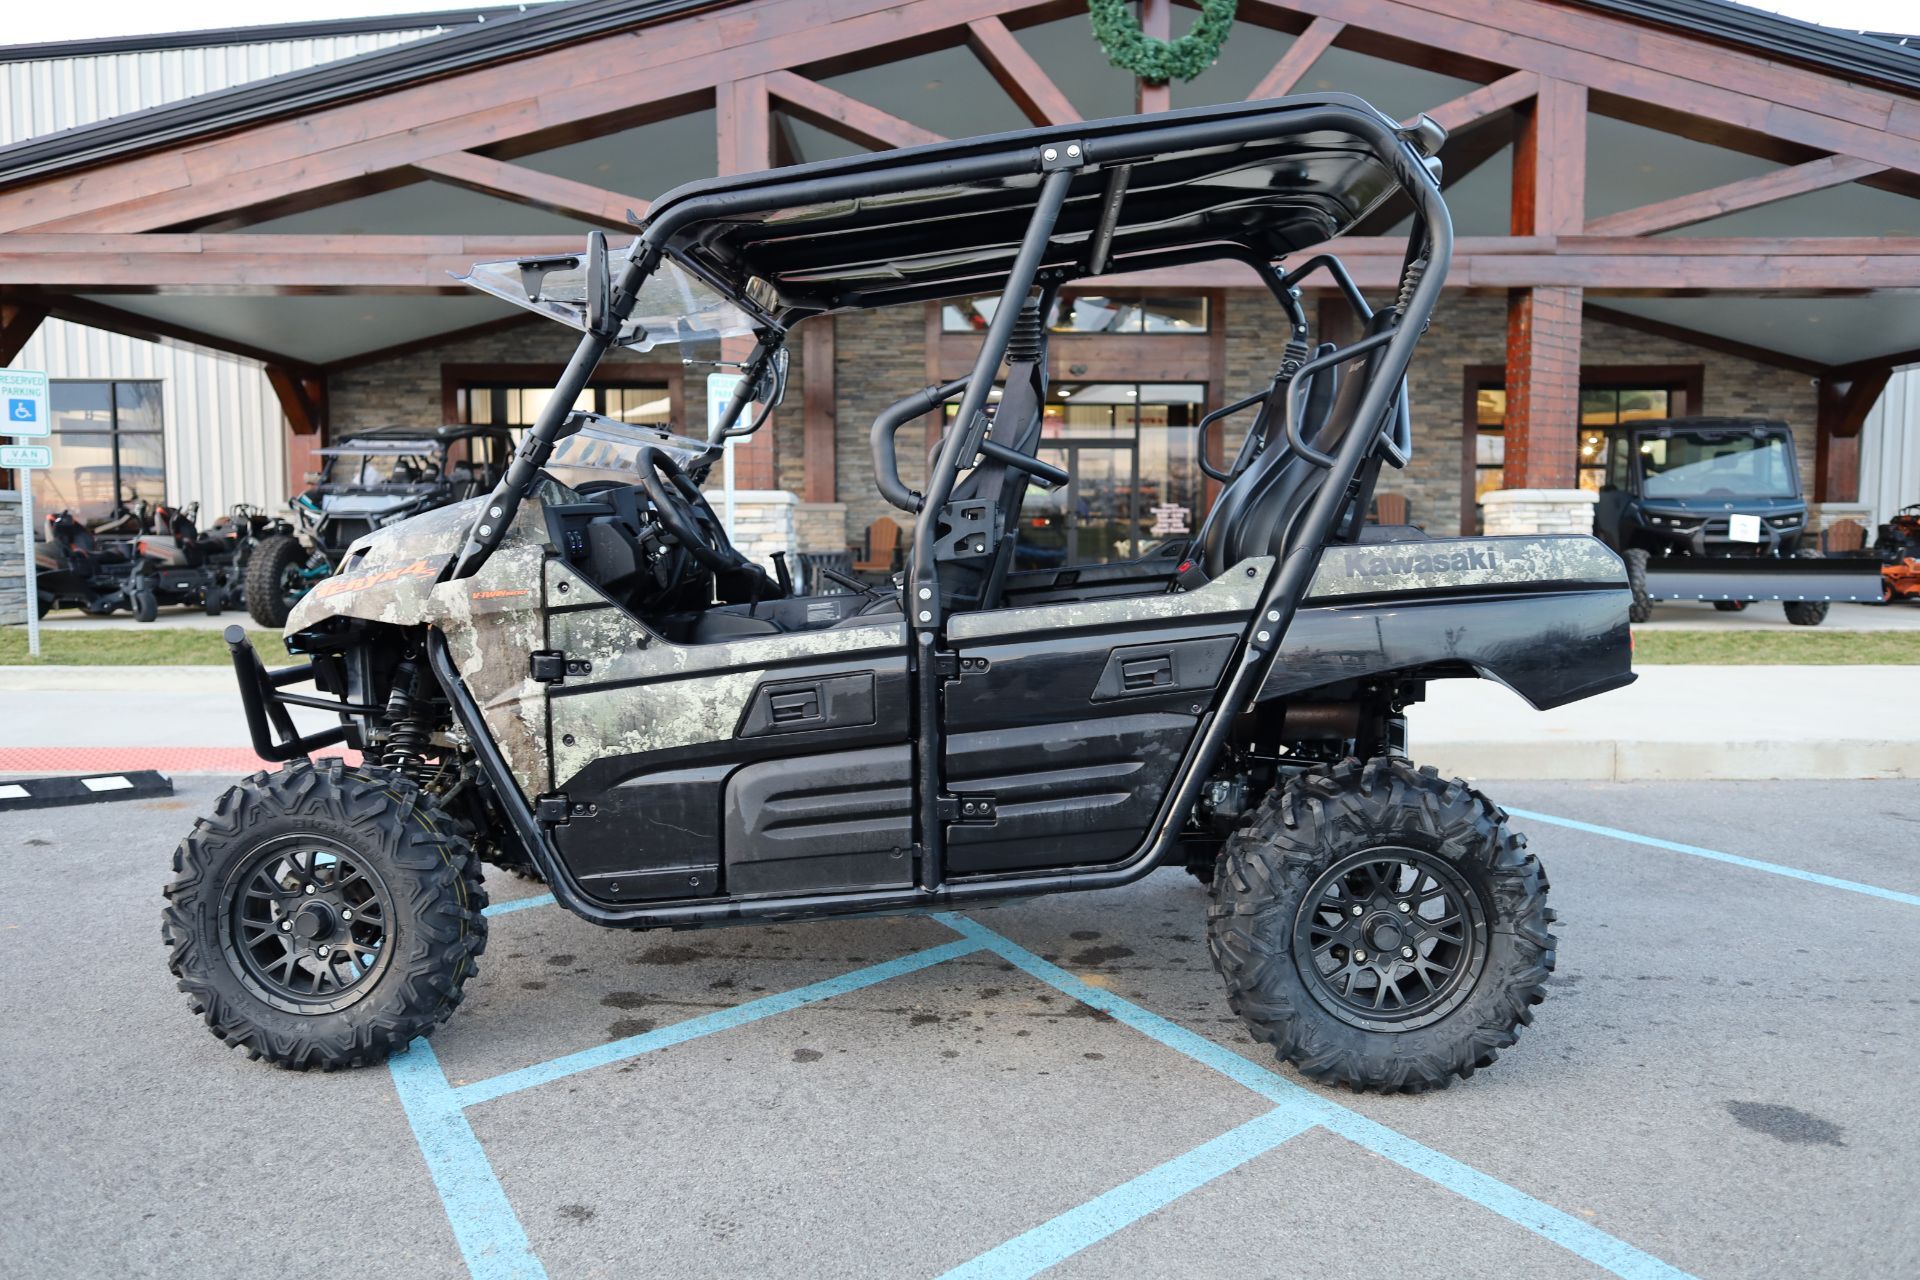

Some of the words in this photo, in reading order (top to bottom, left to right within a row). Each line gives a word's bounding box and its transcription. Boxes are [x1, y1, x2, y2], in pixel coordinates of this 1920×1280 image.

[2, 386, 41, 397] PARKING
[11, 450, 39, 458] VAN
[1344, 546, 1496, 577] Kawasaki
